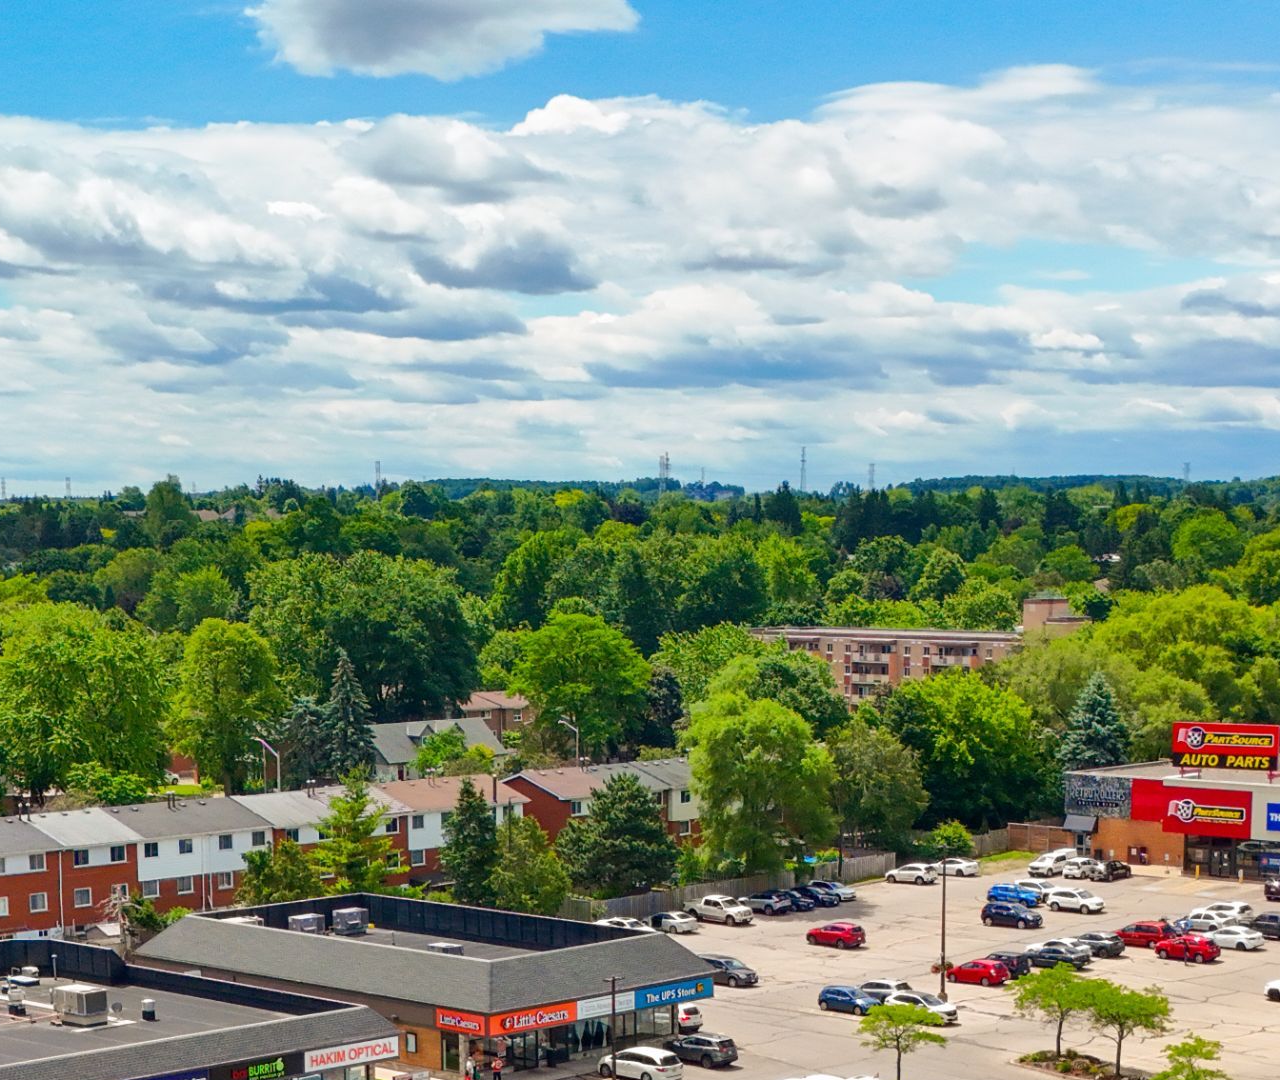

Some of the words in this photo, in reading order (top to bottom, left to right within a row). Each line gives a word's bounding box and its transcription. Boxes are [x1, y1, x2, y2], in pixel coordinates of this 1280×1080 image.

[1180, 754, 1219, 766] AUTO
[1226, 755, 1270, 769] PARTS
[646, 993, 660, 1003] The
[661, 989, 676, 1001] UPS
[677, 987, 696, 998] Store
[513, 1013, 536, 1028] Little
[536, 1009, 569, 1024] Caesars
[310, 1050, 346, 1067] HAKIM
[348, 1041, 395, 1061] OPTICAL
